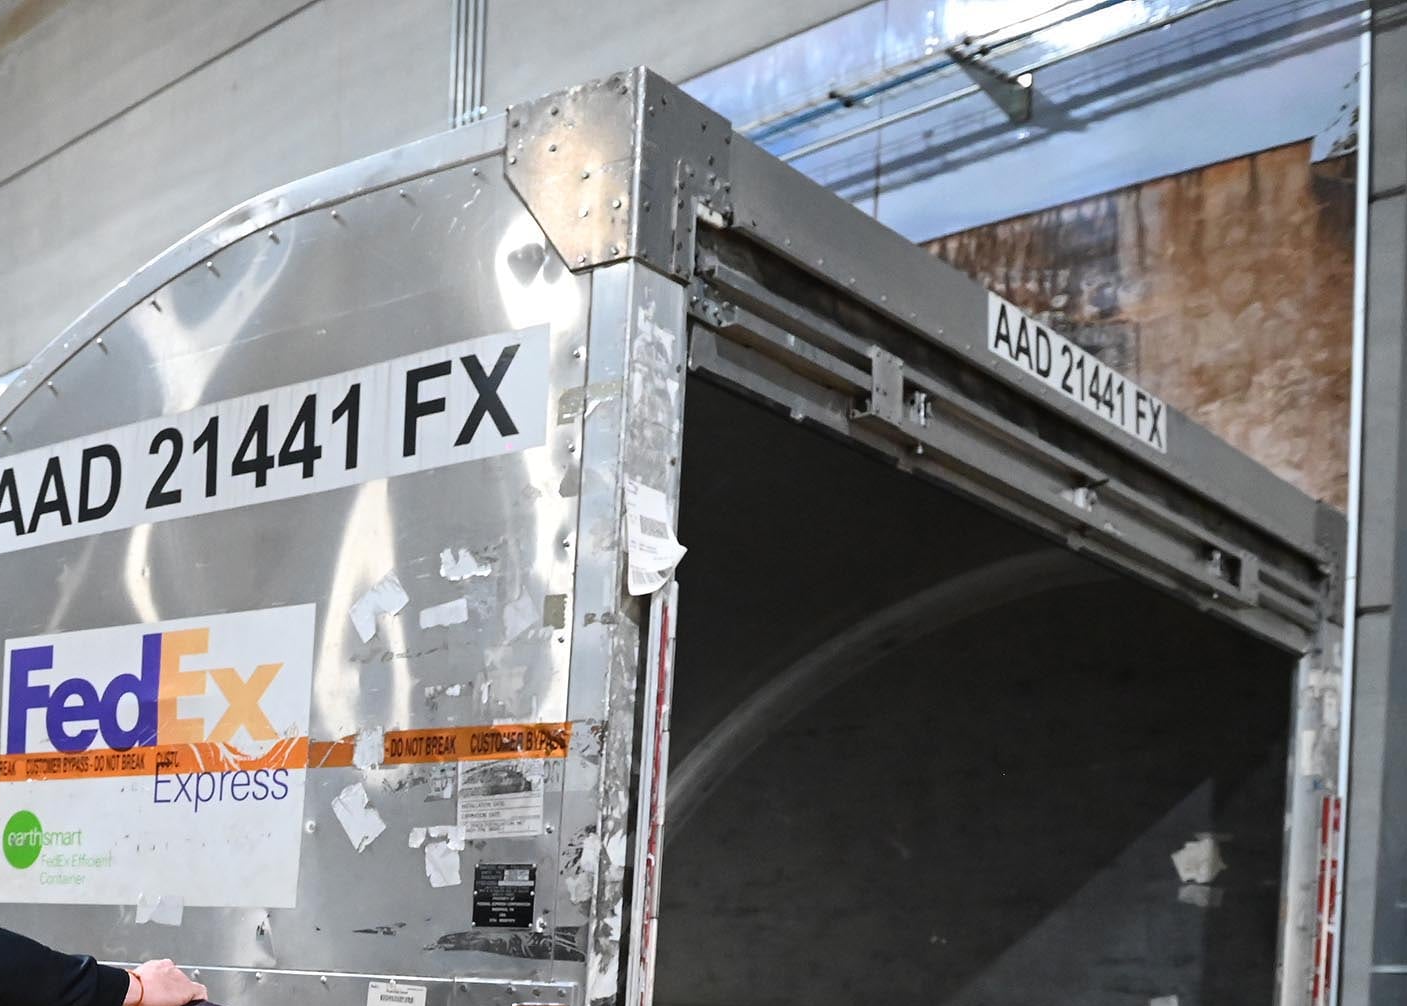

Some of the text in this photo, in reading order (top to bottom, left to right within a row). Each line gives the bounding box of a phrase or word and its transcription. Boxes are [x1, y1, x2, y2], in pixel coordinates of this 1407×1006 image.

[994, 303, 1163, 449] AAD 21441 FX
[145, 383, 361, 510] 21441
[402, 344, 520, 458] FX
[6, 627, 284, 755] FedEx
[26, 757, 62, 775] CUSTOMER
[63, 756, 89, 773] BYPASS
[94, 755, 104, 772] DO
[105, 754, 120, 771] NOT
[121, 752, 145, 771] BREAK
[154, 761, 289, 813] Express
[390, 738, 402, 758] DO
[405, 736, 426, 757] NOT
[426, 734, 456, 756] BREAK
